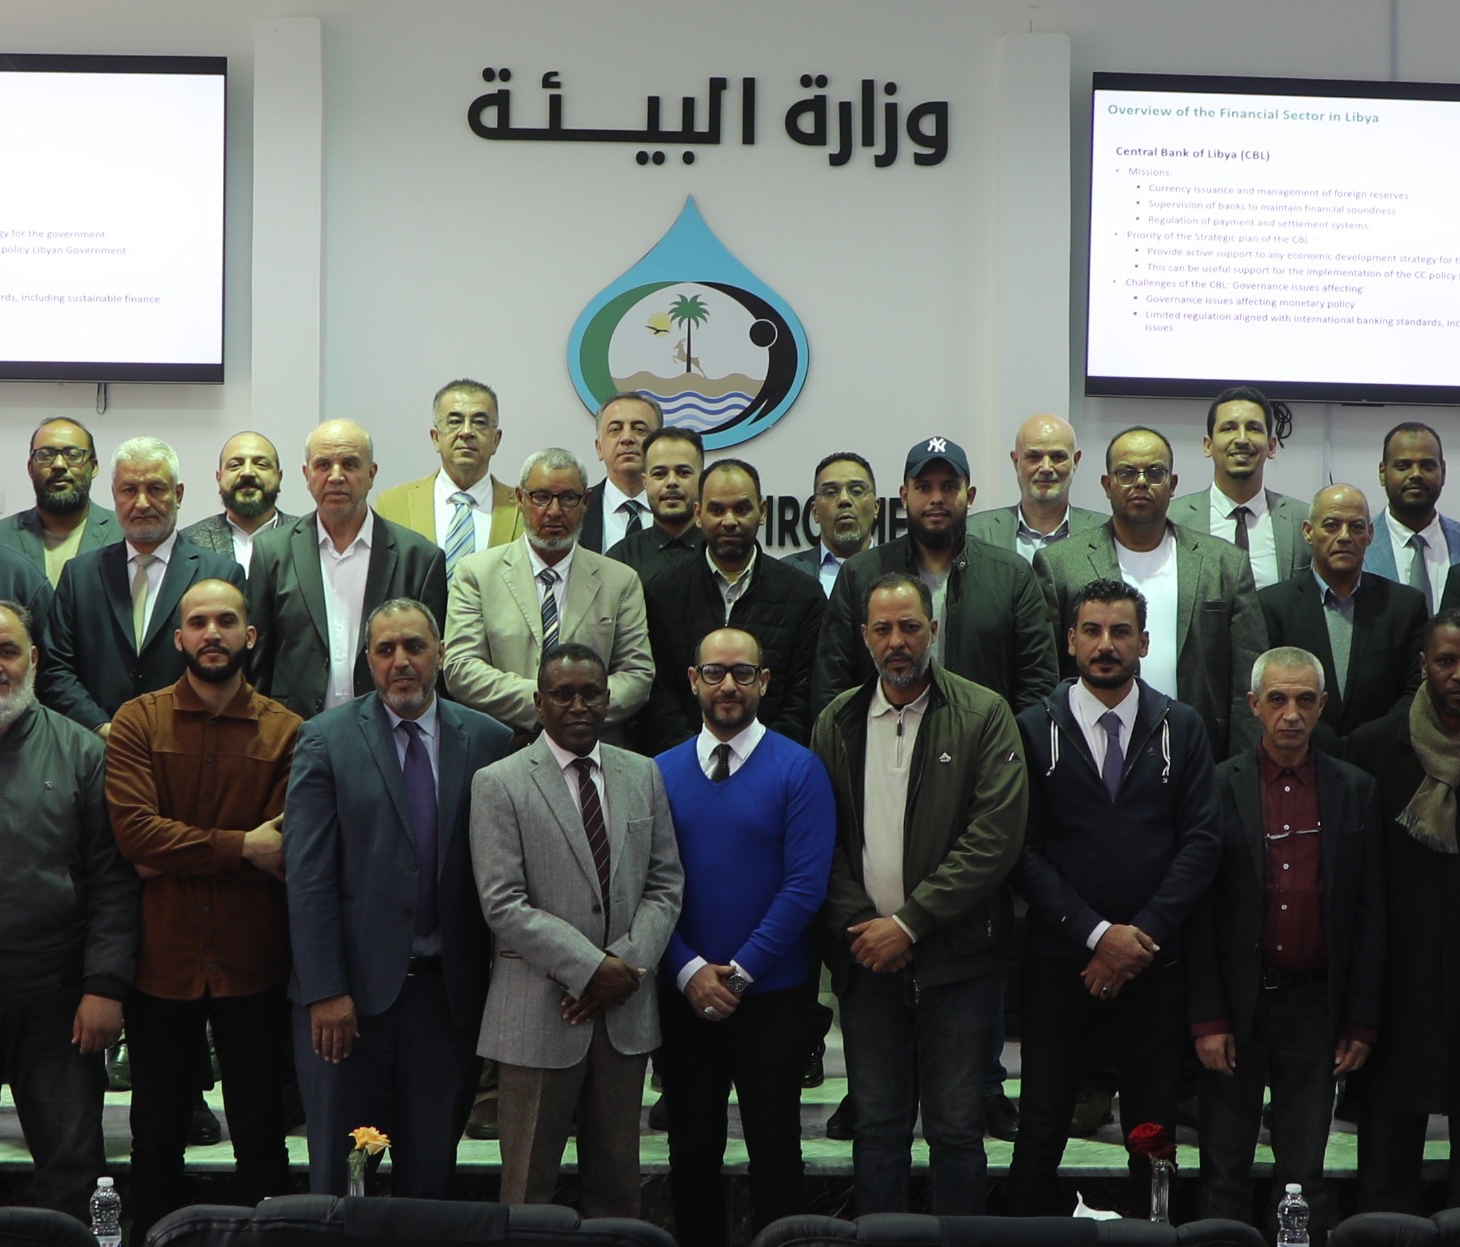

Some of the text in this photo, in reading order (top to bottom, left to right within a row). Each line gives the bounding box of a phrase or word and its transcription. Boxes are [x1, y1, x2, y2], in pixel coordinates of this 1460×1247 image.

[785, 74, 949, 167] وزارة
[1107, 104, 1379, 124] Overview of the Financial Sector in Libya
[1115, 146, 1269, 161] Central Bank of Libya (CBL)
[20, 293, 65, 304] including
[67, 293, 122, 302] sustainable
[124, 294, 160, 303] finance
[1145, 310, 1180, 319] Limited
[1182, 311, 1231, 322] regulation
[1233, 312, 1268, 323] aligned
[1270, 313, 1291, 322] with
[1293, 314, 1354, 324] international
[1356, 316, 1393, 327] banking
